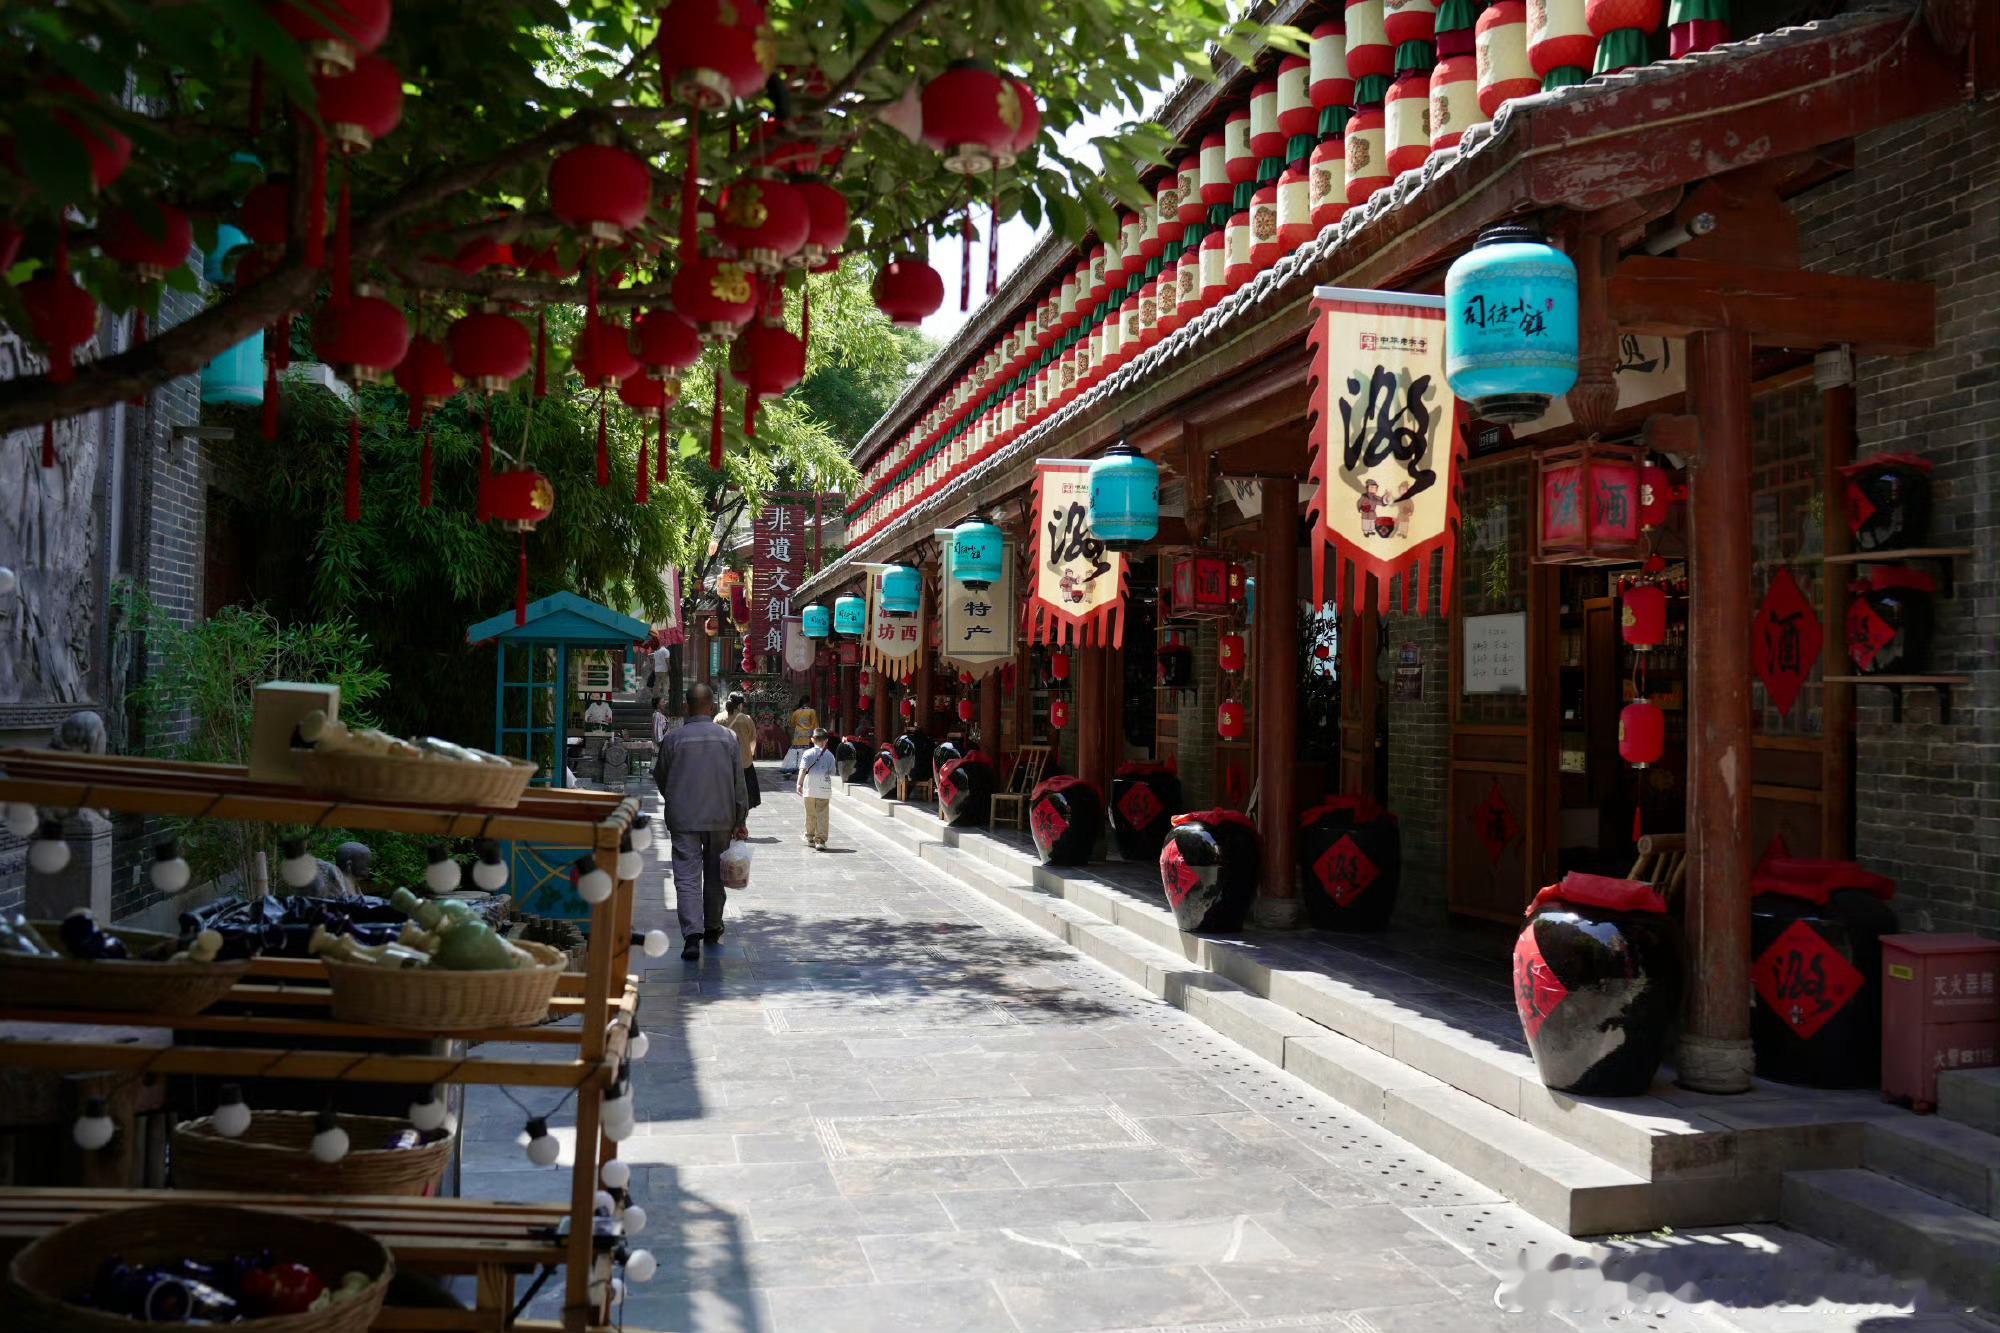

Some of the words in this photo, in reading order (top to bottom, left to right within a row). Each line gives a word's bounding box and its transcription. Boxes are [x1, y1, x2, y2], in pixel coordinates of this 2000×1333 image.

[1463, 294, 1549, 337] 司徒小镇
[1597, 480, 1627, 528] 酒
[963, 601, 992, 640] 特产
